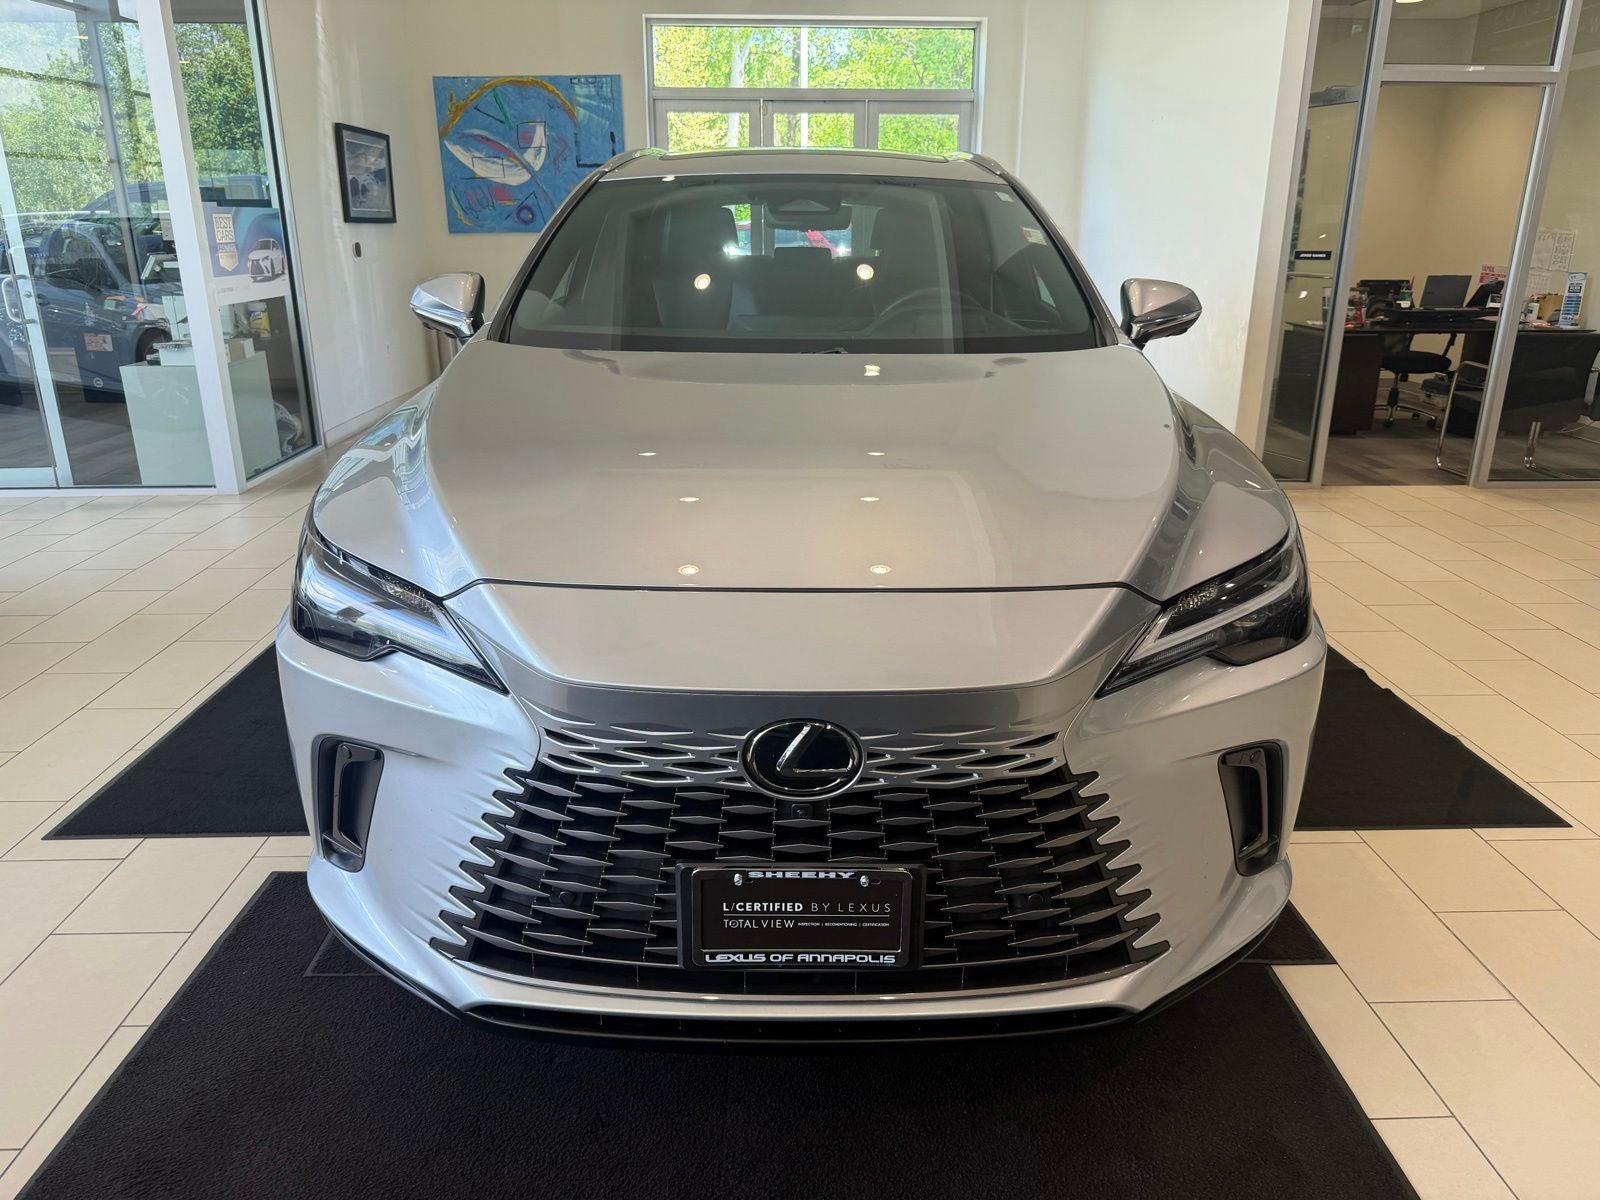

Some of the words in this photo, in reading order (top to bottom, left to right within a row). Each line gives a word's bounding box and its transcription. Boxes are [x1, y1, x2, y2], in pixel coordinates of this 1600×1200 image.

[214, 216, 232, 229] BEST
[216, 229, 234, 241] CARS
[748, 871, 855, 879] SHEEHY
[722, 902, 803, 912] L/CERTIFIED
[811, 902, 830, 912] BY
[838, 902, 891, 913] LEXUS
[723, 919, 759, 929] TOTAL
[761, 919, 795, 929] VIEW
[705, 953, 767, 963] LEXUS
[769, 953, 794, 963] OF
[797, 953, 896, 965] ANNAPOLIS
